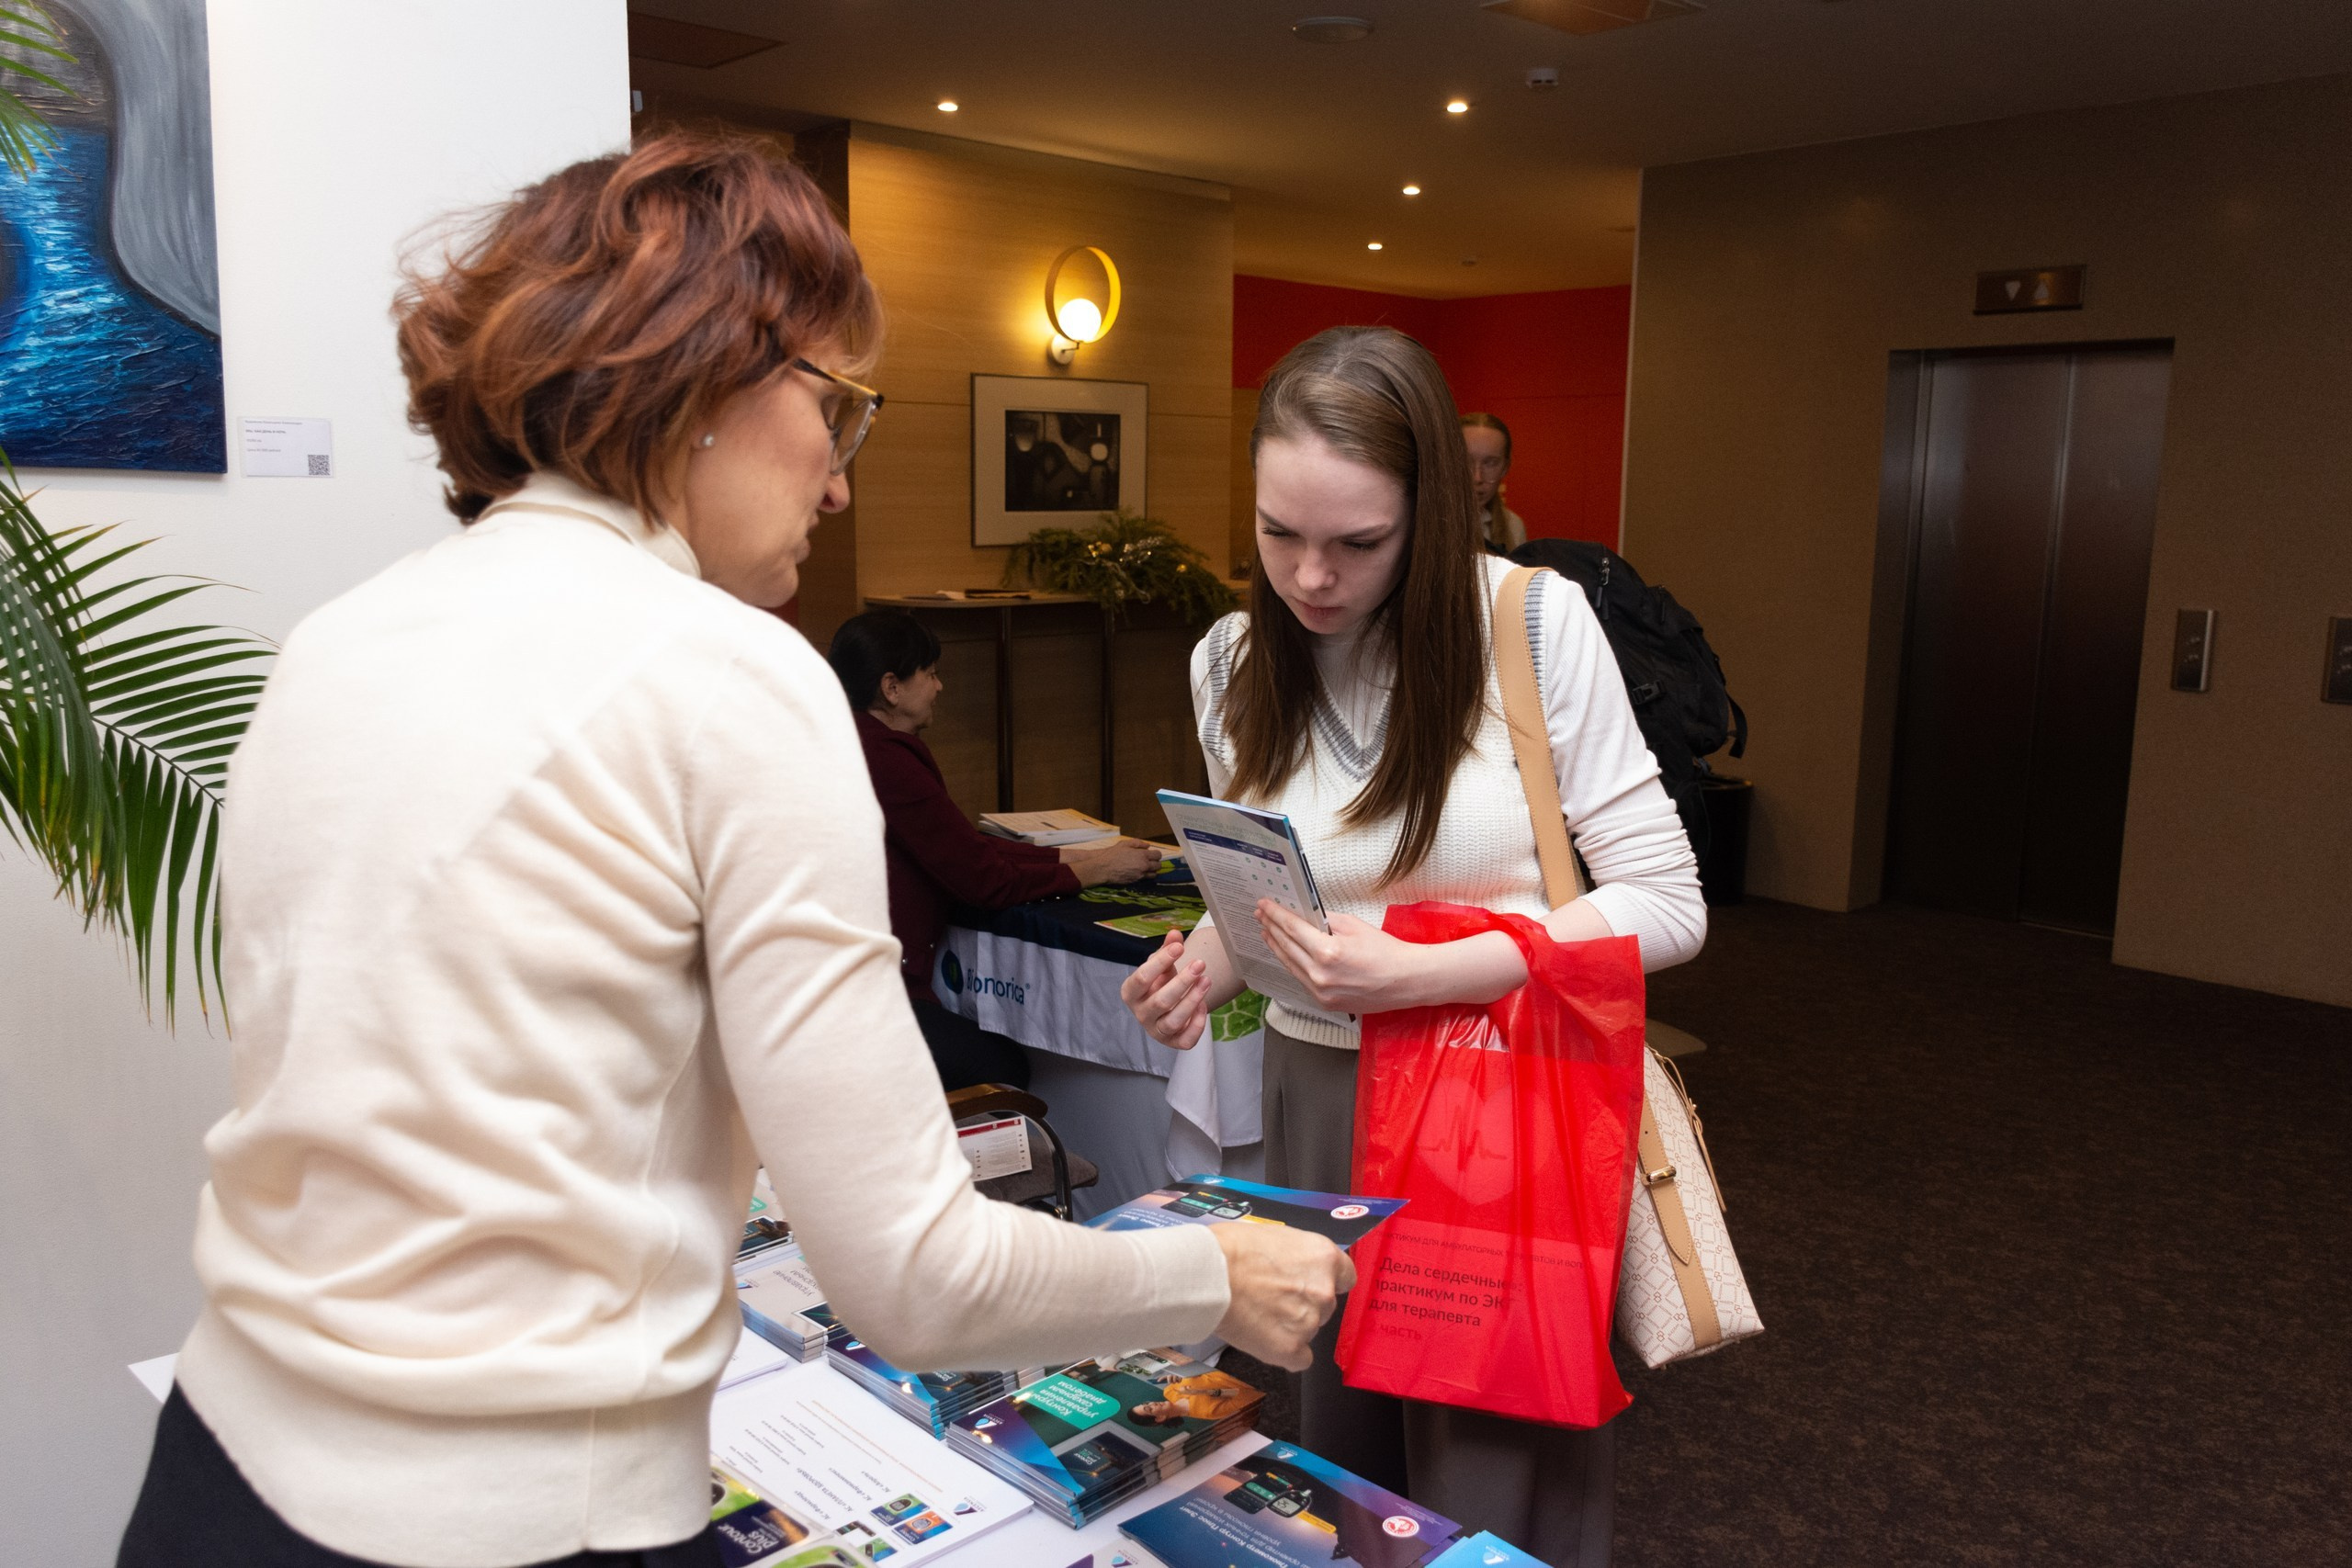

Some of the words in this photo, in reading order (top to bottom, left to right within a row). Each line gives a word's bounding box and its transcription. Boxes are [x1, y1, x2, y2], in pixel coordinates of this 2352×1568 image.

[1379, 1257, 1420, 1276] Дела
[790, 1269, 818, 1290] ахарным
[1459, 1293, 1478, 1305] по
[1482, 1294, 1511, 1309] ЭК
[1369, 1298, 1397, 1313] для
[1402, 1303, 1481, 1326] терапевта
[1038, 1389, 1100, 1418] управления
[1047, 1384, 1093, 1408] сахарным
[1057, 1381, 1108, 1405] диабетом
[1179, 1506, 1199, 1518] Элит
[1198, 1515, 1220, 1530] Плюс
[718, 1522, 763, 1554] Contour
[747, 1529, 780, 1550] plus
[1219, 1528, 1247, 1547] Контур
